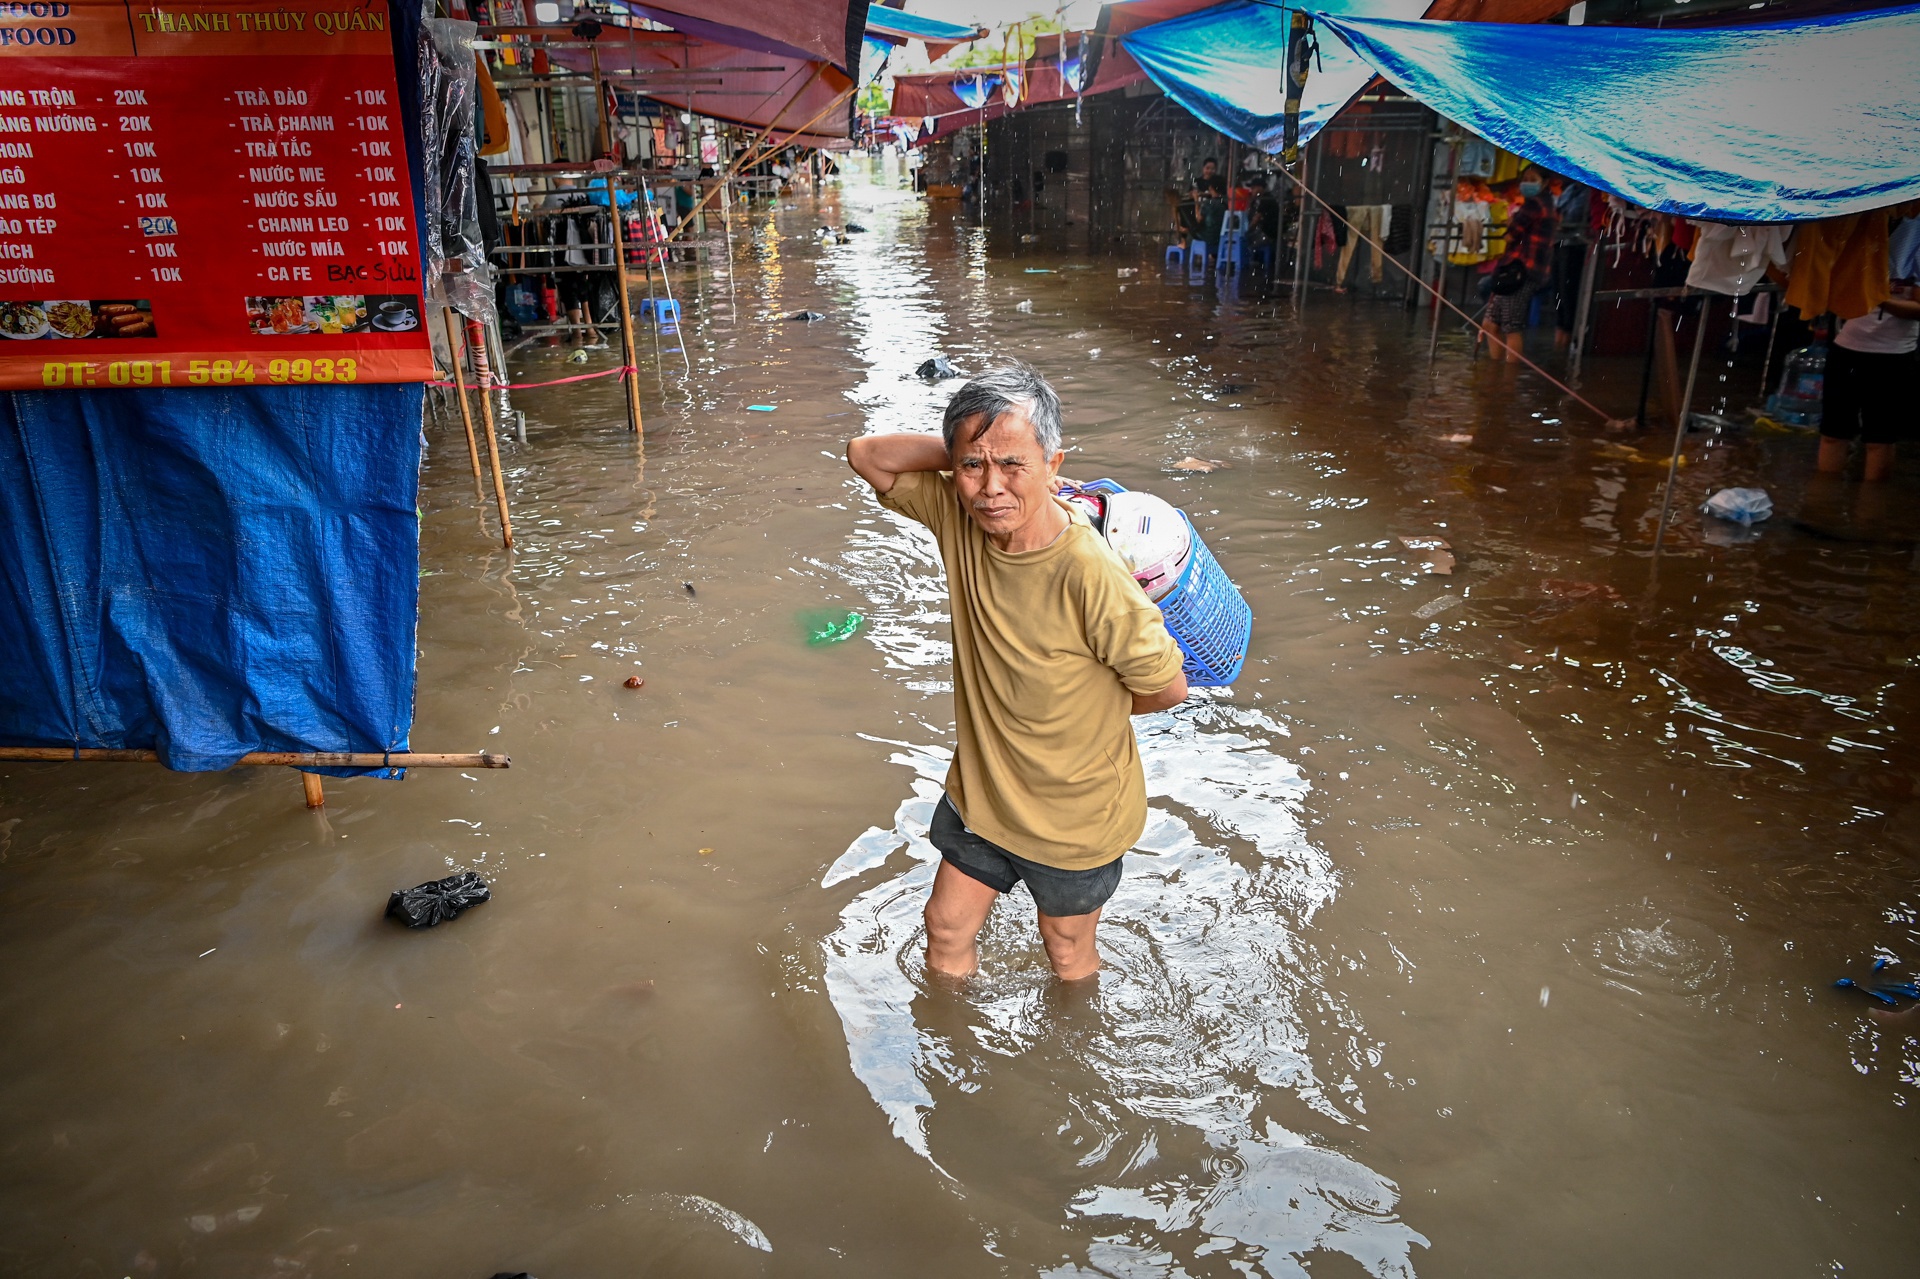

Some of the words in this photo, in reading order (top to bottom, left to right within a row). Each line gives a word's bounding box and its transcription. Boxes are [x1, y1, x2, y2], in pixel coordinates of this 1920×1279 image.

[139, 13, 230, 33] THANH
[235, 7, 307, 32] THỦY
[313, 6, 385, 36] QUÁN
[0, 27, 77, 46] FOOD
[0, 90, 26, 106] NG
[28, 87, 77, 109] TRỘN
[114, 90, 148, 106] 20K
[234, 87, 271, 106] TRÀ
[274, 87, 308, 106] ĐÀO
[354, 90, 387, 105] 10K
[35, 113, 97, 132] NƯỚNG
[119, 116, 152, 132] 20K
[240, 113, 275, 132] TRÀ
[278, 116, 335, 132] CHANH
[356, 116, 389, 131] 10K
[124, 142, 157, 157] 10K
[245, 139, 278, 157] TRÀ
[281, 136, 312, 157] TẮC
[359, 142, 392, 157] 10K
[0, 166, 26, 184] GÔ
[130, 168, 163, 183] 10K
[249, 165, 295, 182] NƯỚC
[299, 167, 326, 182] ME
[364, 167, 396, 182] 10K
[33, 192, 57, 209] BƠ
[136, 193, 168, 208] 10K
[253, 190, 299, 208] NƯỚC
[304, 187, 338, 207] SẤU
[369, 192, 401, 207] 10K
[26, 216, 57, 234] TÉP
[140, 217, 177, 236] 20K
[258, 217, 314, 233] CHANH
[318, 217, 350, 232] LEO
[375, 217, 407, 231] 10K
[145, 243, 178, 258] 10K
[262, 240, 307, 257] NƯỚC
[311, 239, 345, 256] MÍA
[378, 241, 410, 256] 10K
[151, 267, 183, 282] 10K
[267, 267, 290, 281] CA
[293, 267, 313, 281] FE
[42, 362, 97, 387] ĐT:
[108, 360, 172, 385] 091
[188, 359, 256, 384] 584
[268, 358, 357, 382] 9933
